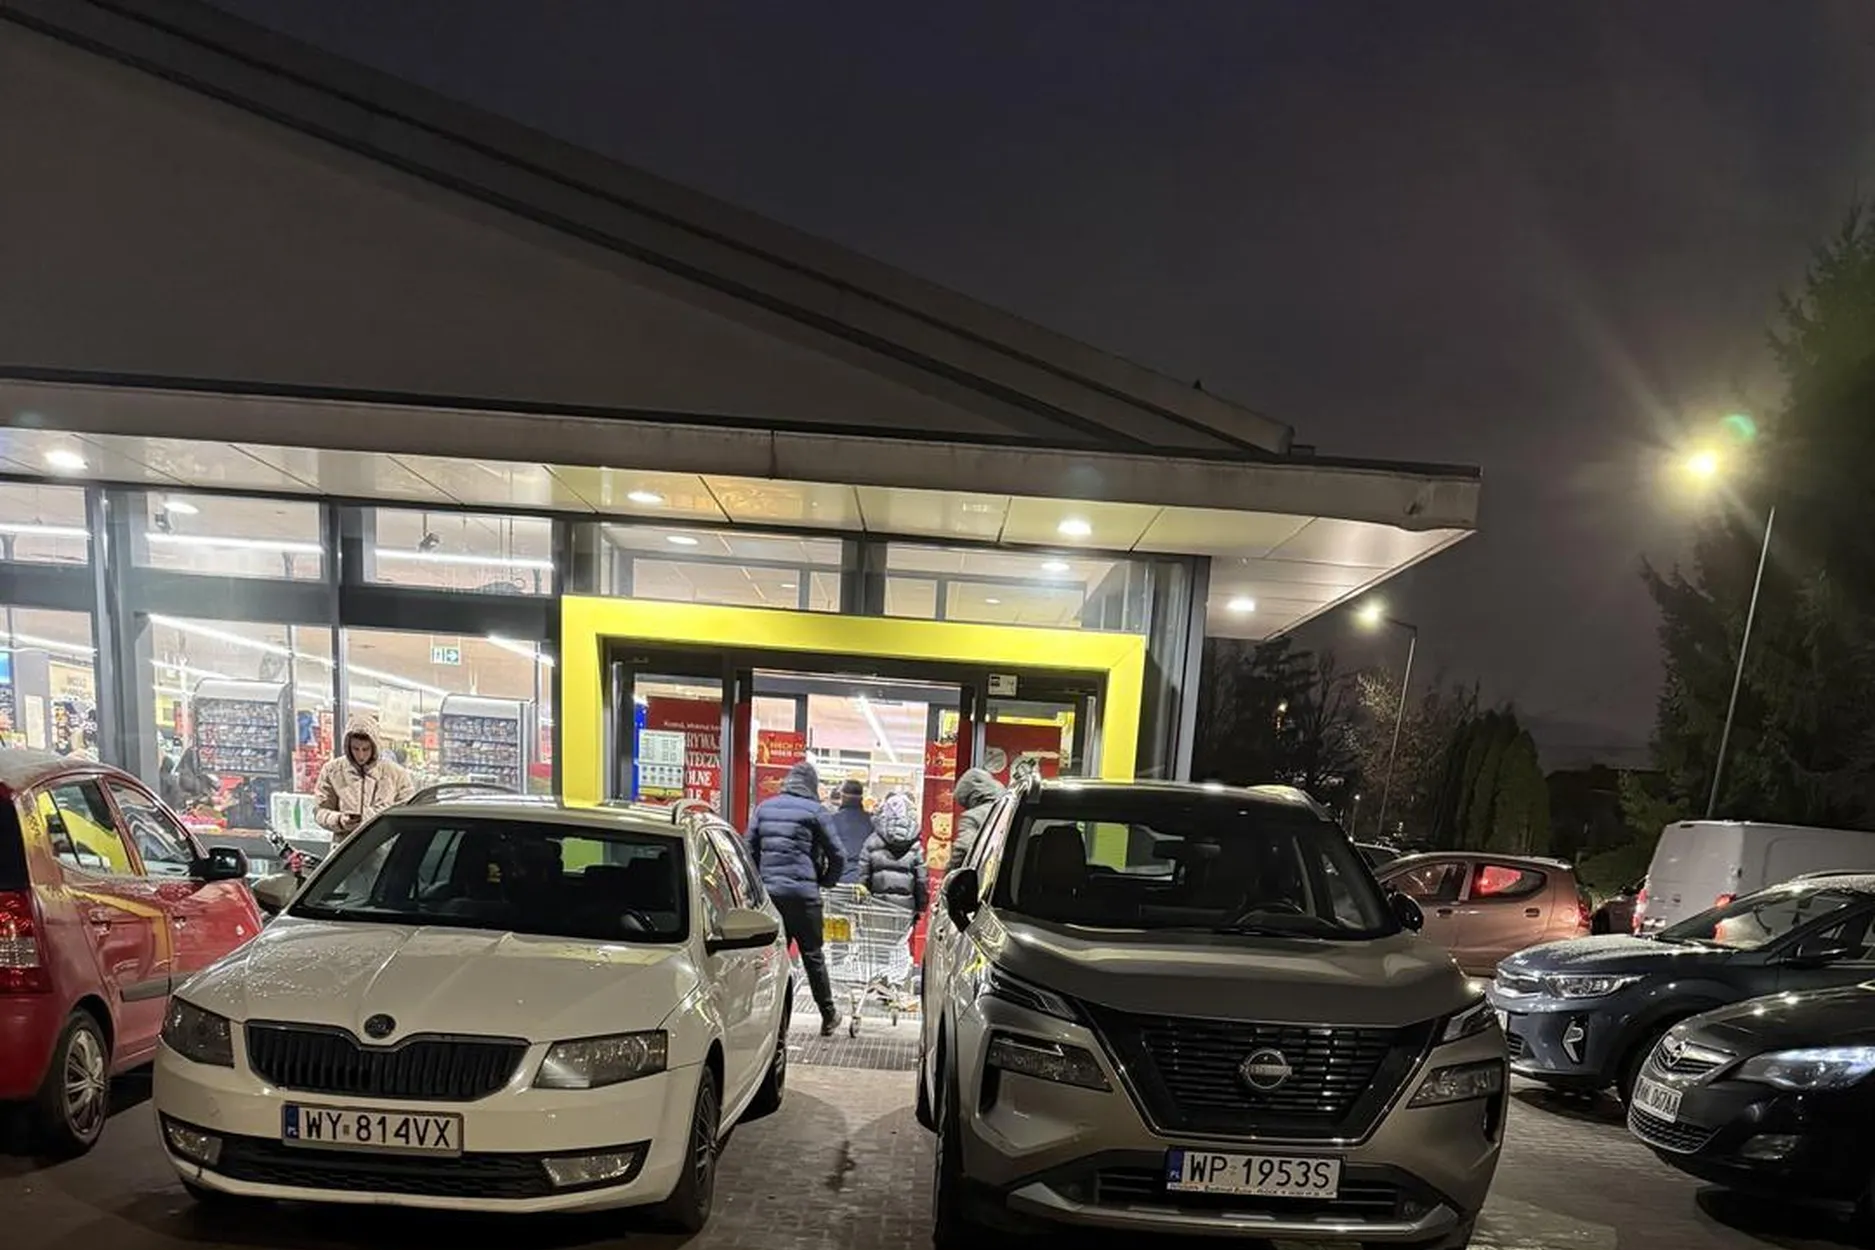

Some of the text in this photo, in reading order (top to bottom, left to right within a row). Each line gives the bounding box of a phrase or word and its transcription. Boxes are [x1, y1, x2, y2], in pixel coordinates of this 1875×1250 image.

[305, 1110, 451, 1148] WY 814VX
[1190, 1154, 1331, 1189] WP 1953S
